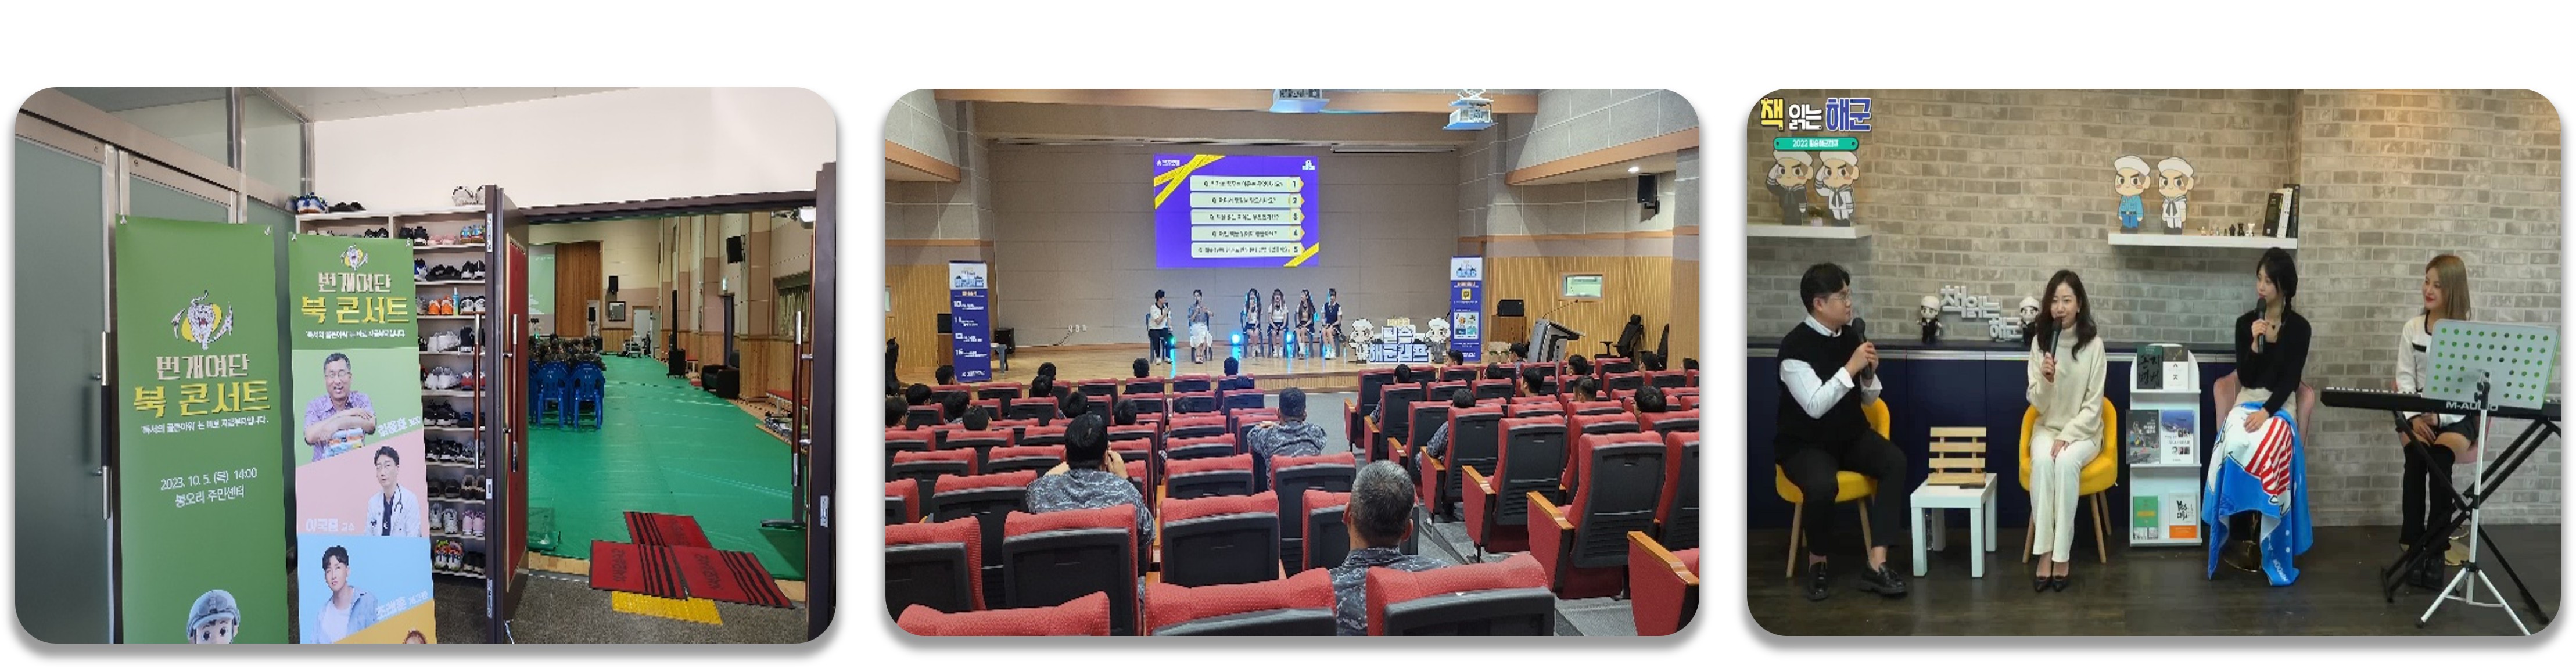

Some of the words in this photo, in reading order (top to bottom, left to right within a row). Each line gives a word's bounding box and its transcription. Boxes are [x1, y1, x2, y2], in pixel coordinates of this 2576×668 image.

[318, 272, 392, 293] 번개여단
[301, 296, 327, 324] 북
[336, 296, 409, 324] 콘서트
[157, 353, 249, 380] 번개여단
[134, 386, 166, 418] 북
[179, 381, 270, 416] 콘서트
[188, 475, 200, 486] 10.
[203, 474, 211, 485] 5.
[208, 484, 245, 502] 주민센터
